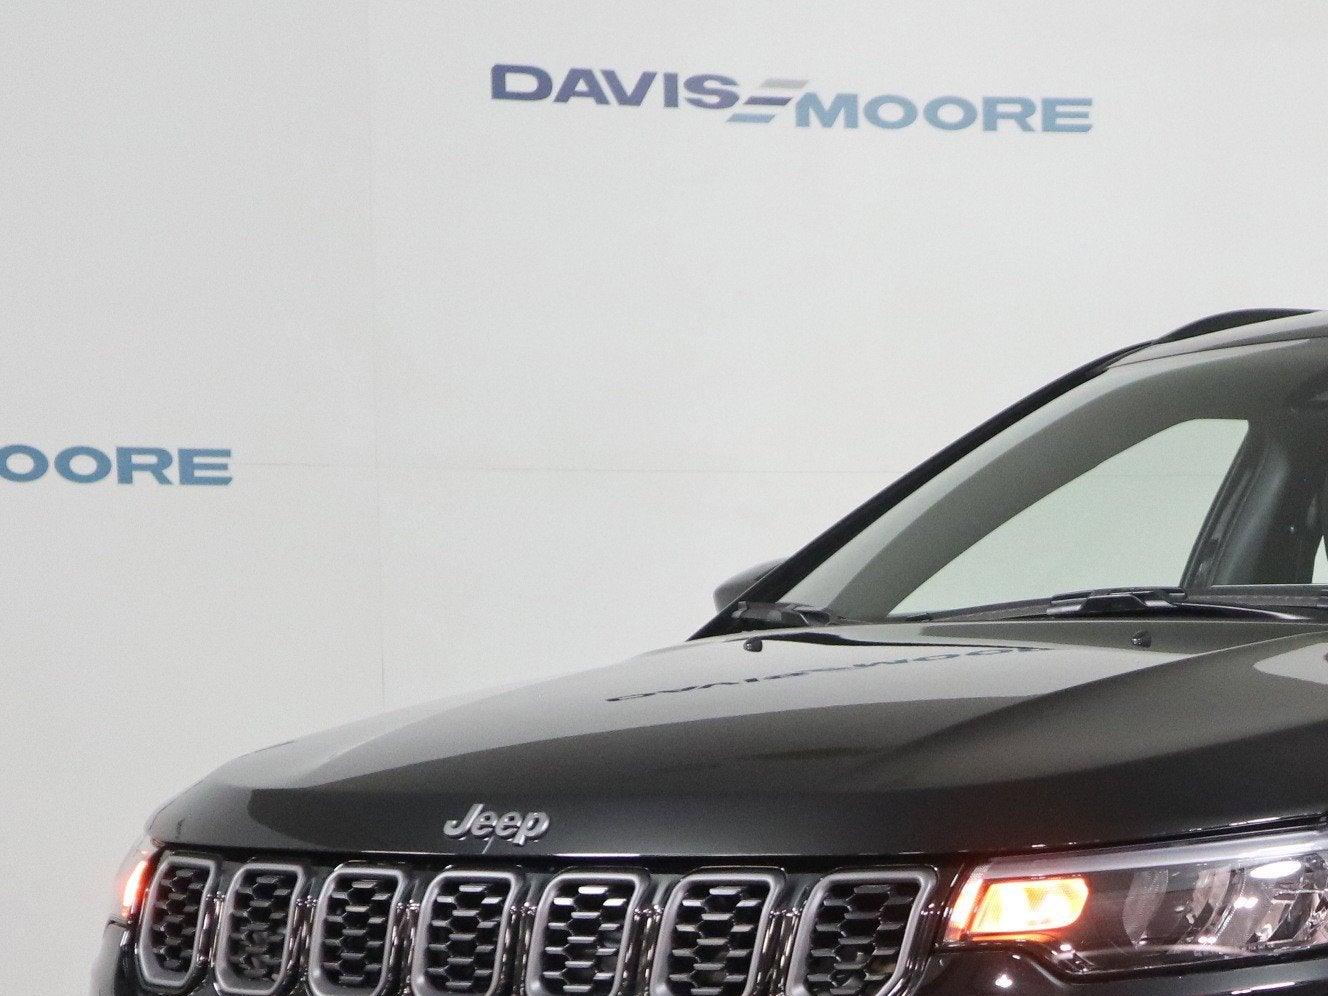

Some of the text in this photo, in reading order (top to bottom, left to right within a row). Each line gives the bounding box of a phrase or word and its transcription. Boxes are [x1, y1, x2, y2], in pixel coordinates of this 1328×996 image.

[490, 63, 1094, 134] DAVIS MOORE
[0, 444, 233, 486] OORE
[443, 803, 550, 847] Jeep
